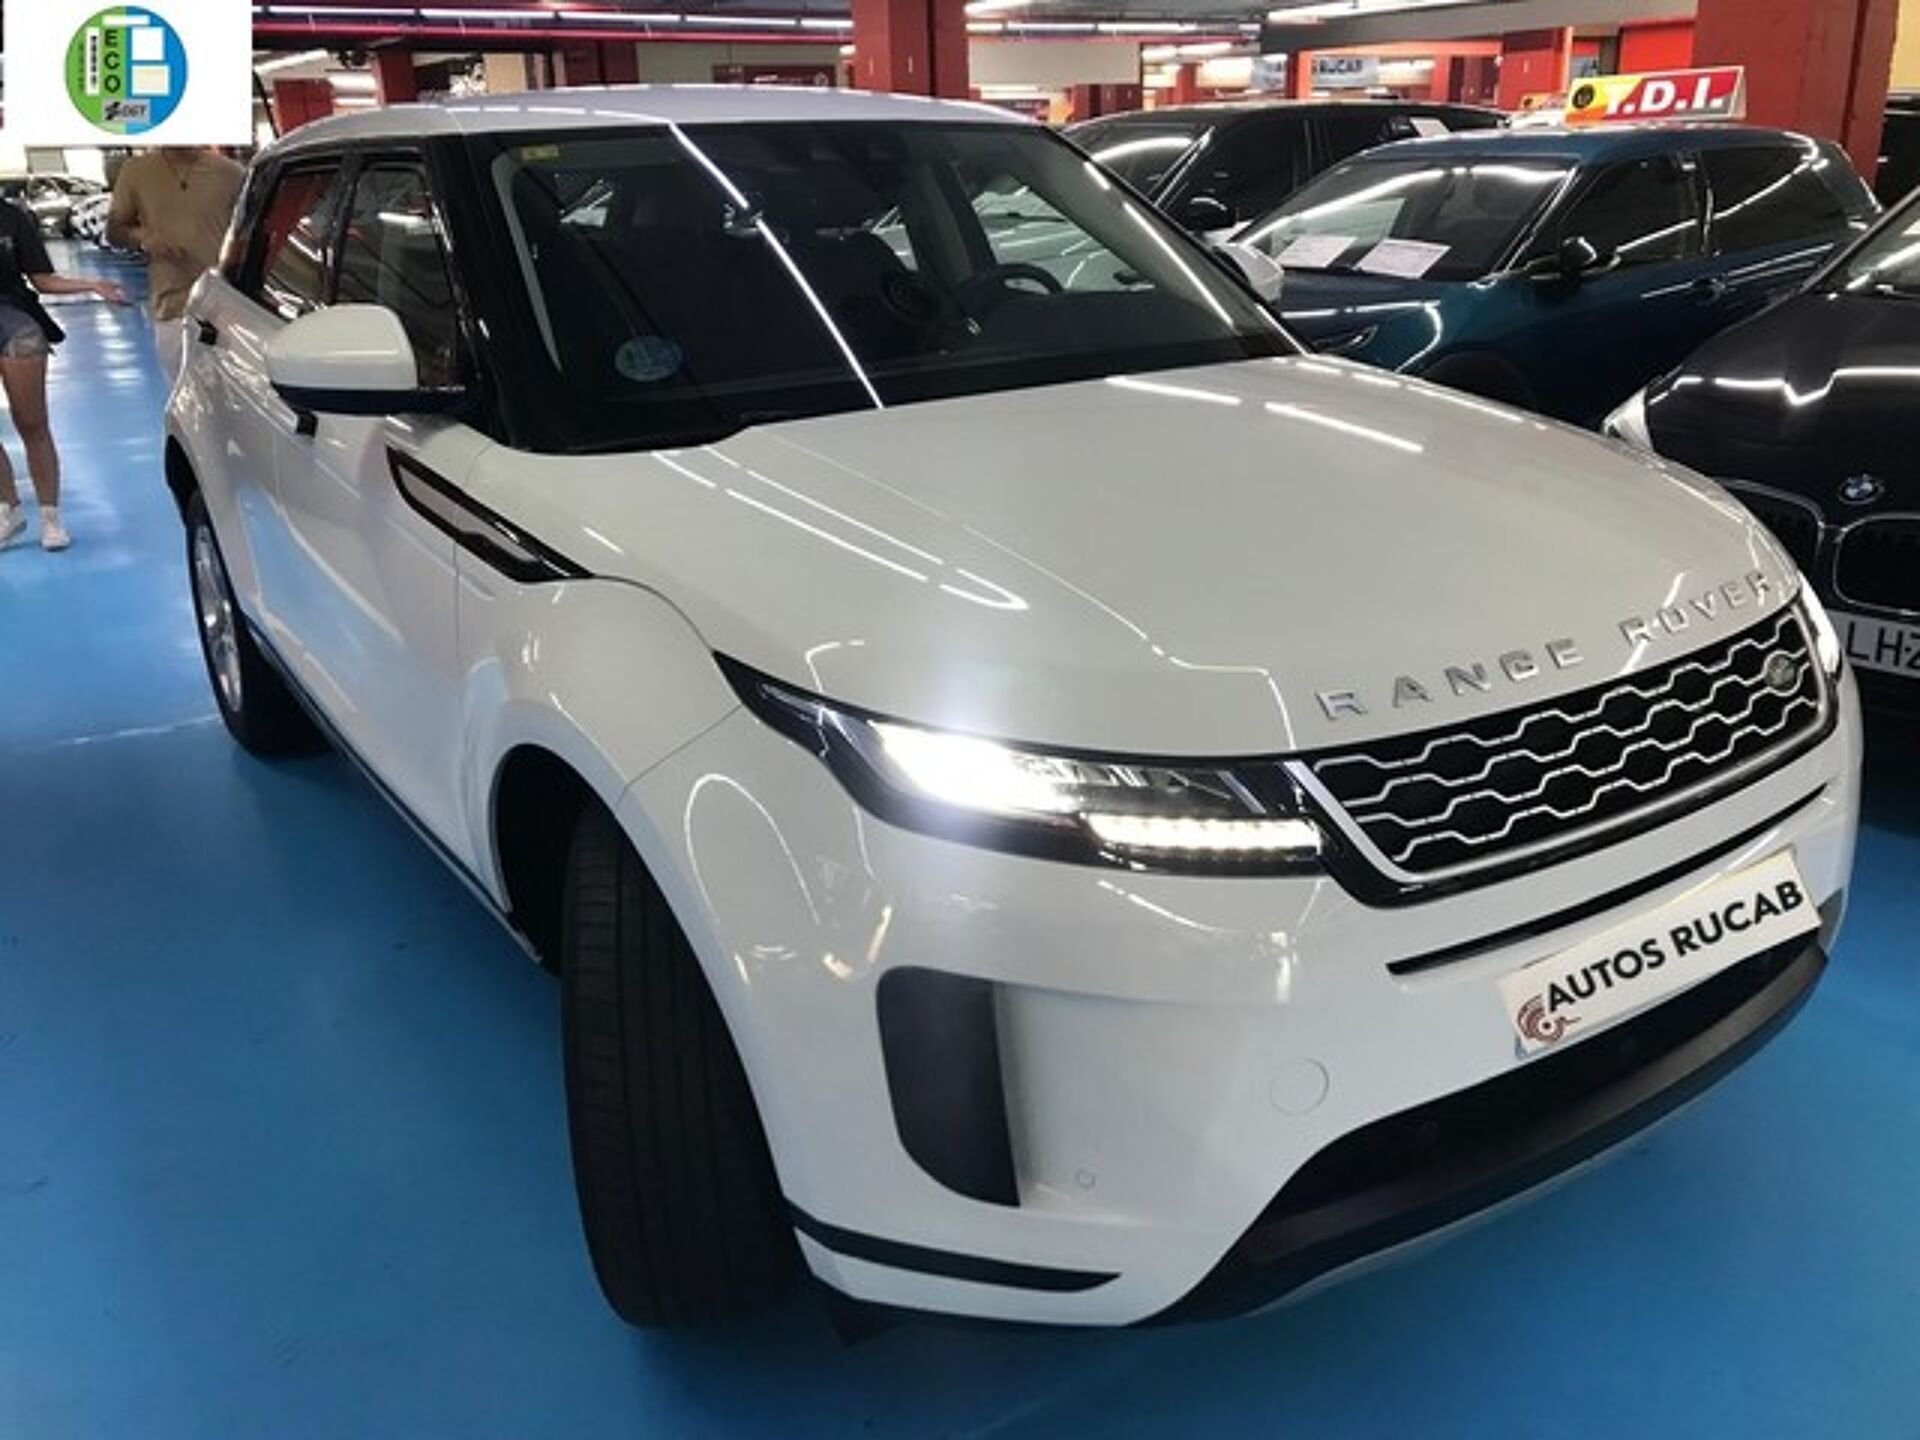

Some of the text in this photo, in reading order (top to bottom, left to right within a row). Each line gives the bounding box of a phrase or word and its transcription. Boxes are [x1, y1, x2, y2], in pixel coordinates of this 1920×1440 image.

[1315, 570, 1772, 721] RANGE ROVER
[1549, 881, 1804, 1013] AUTOS RUCAB
